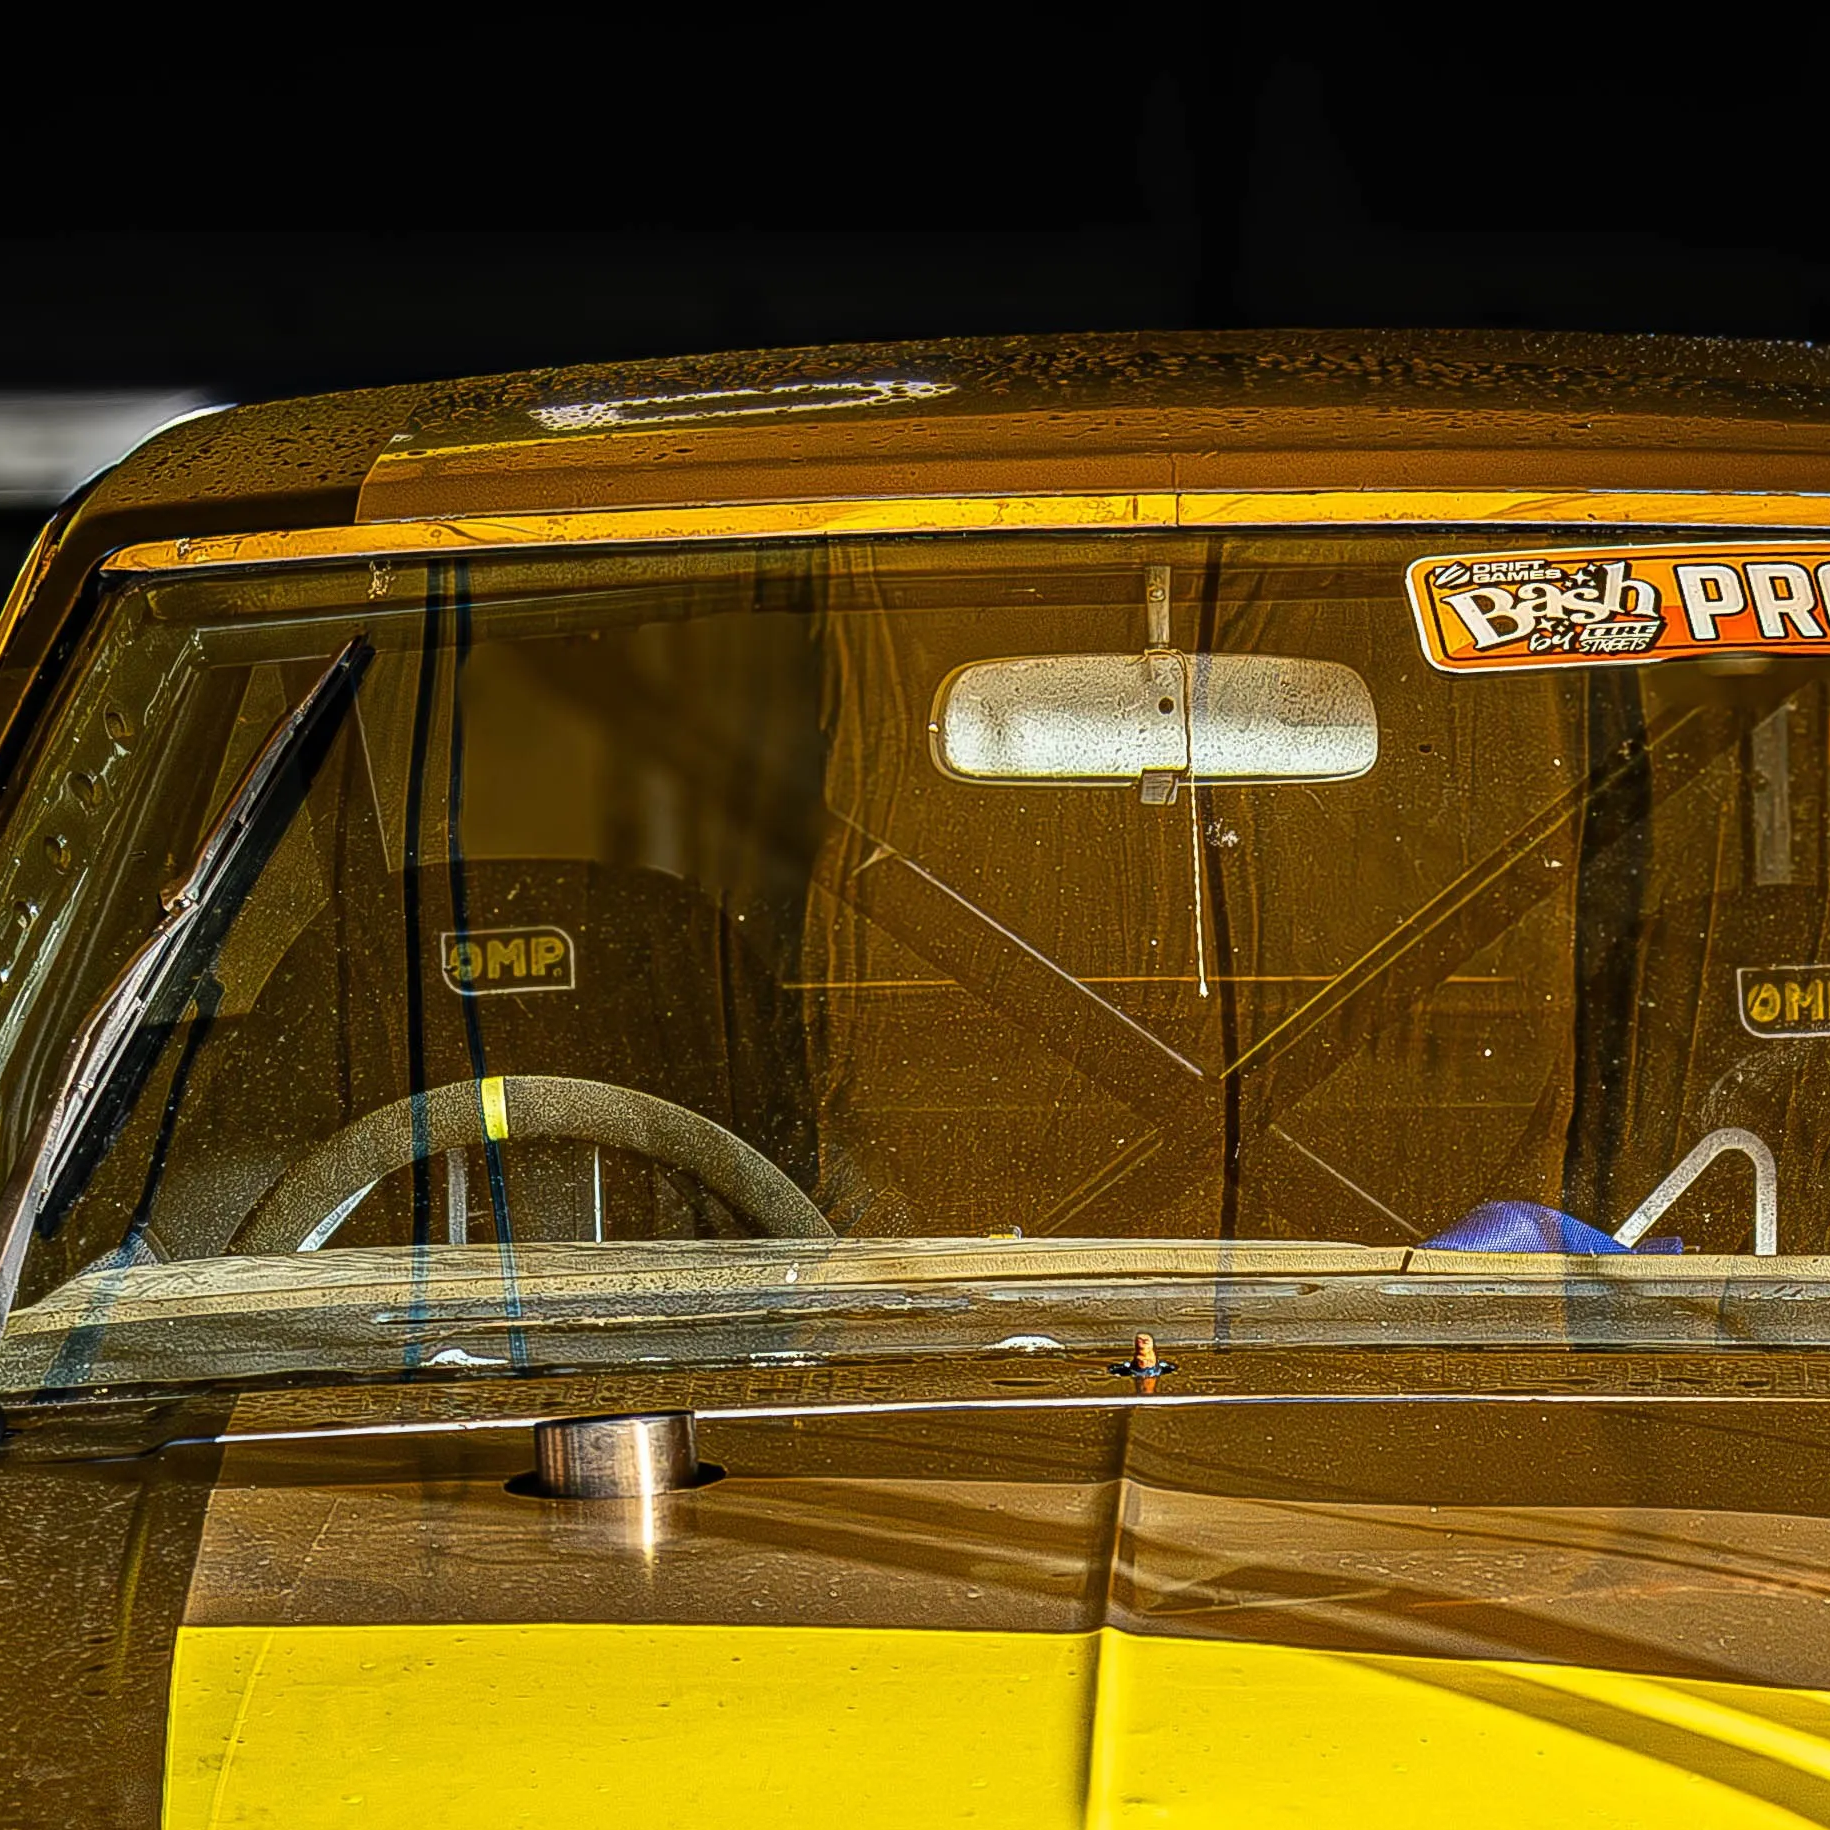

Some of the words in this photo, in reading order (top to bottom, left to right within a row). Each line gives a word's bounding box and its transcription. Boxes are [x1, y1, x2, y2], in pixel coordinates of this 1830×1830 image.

[1472, 561, 1545, 574] DRIFT
[1472, 568, 1562, 583] GAMES
[1441, 561, 1658, 649] Bash
[1578, 637, 1650, 653] STREETS
[449, 936, 565, 980] OMP
